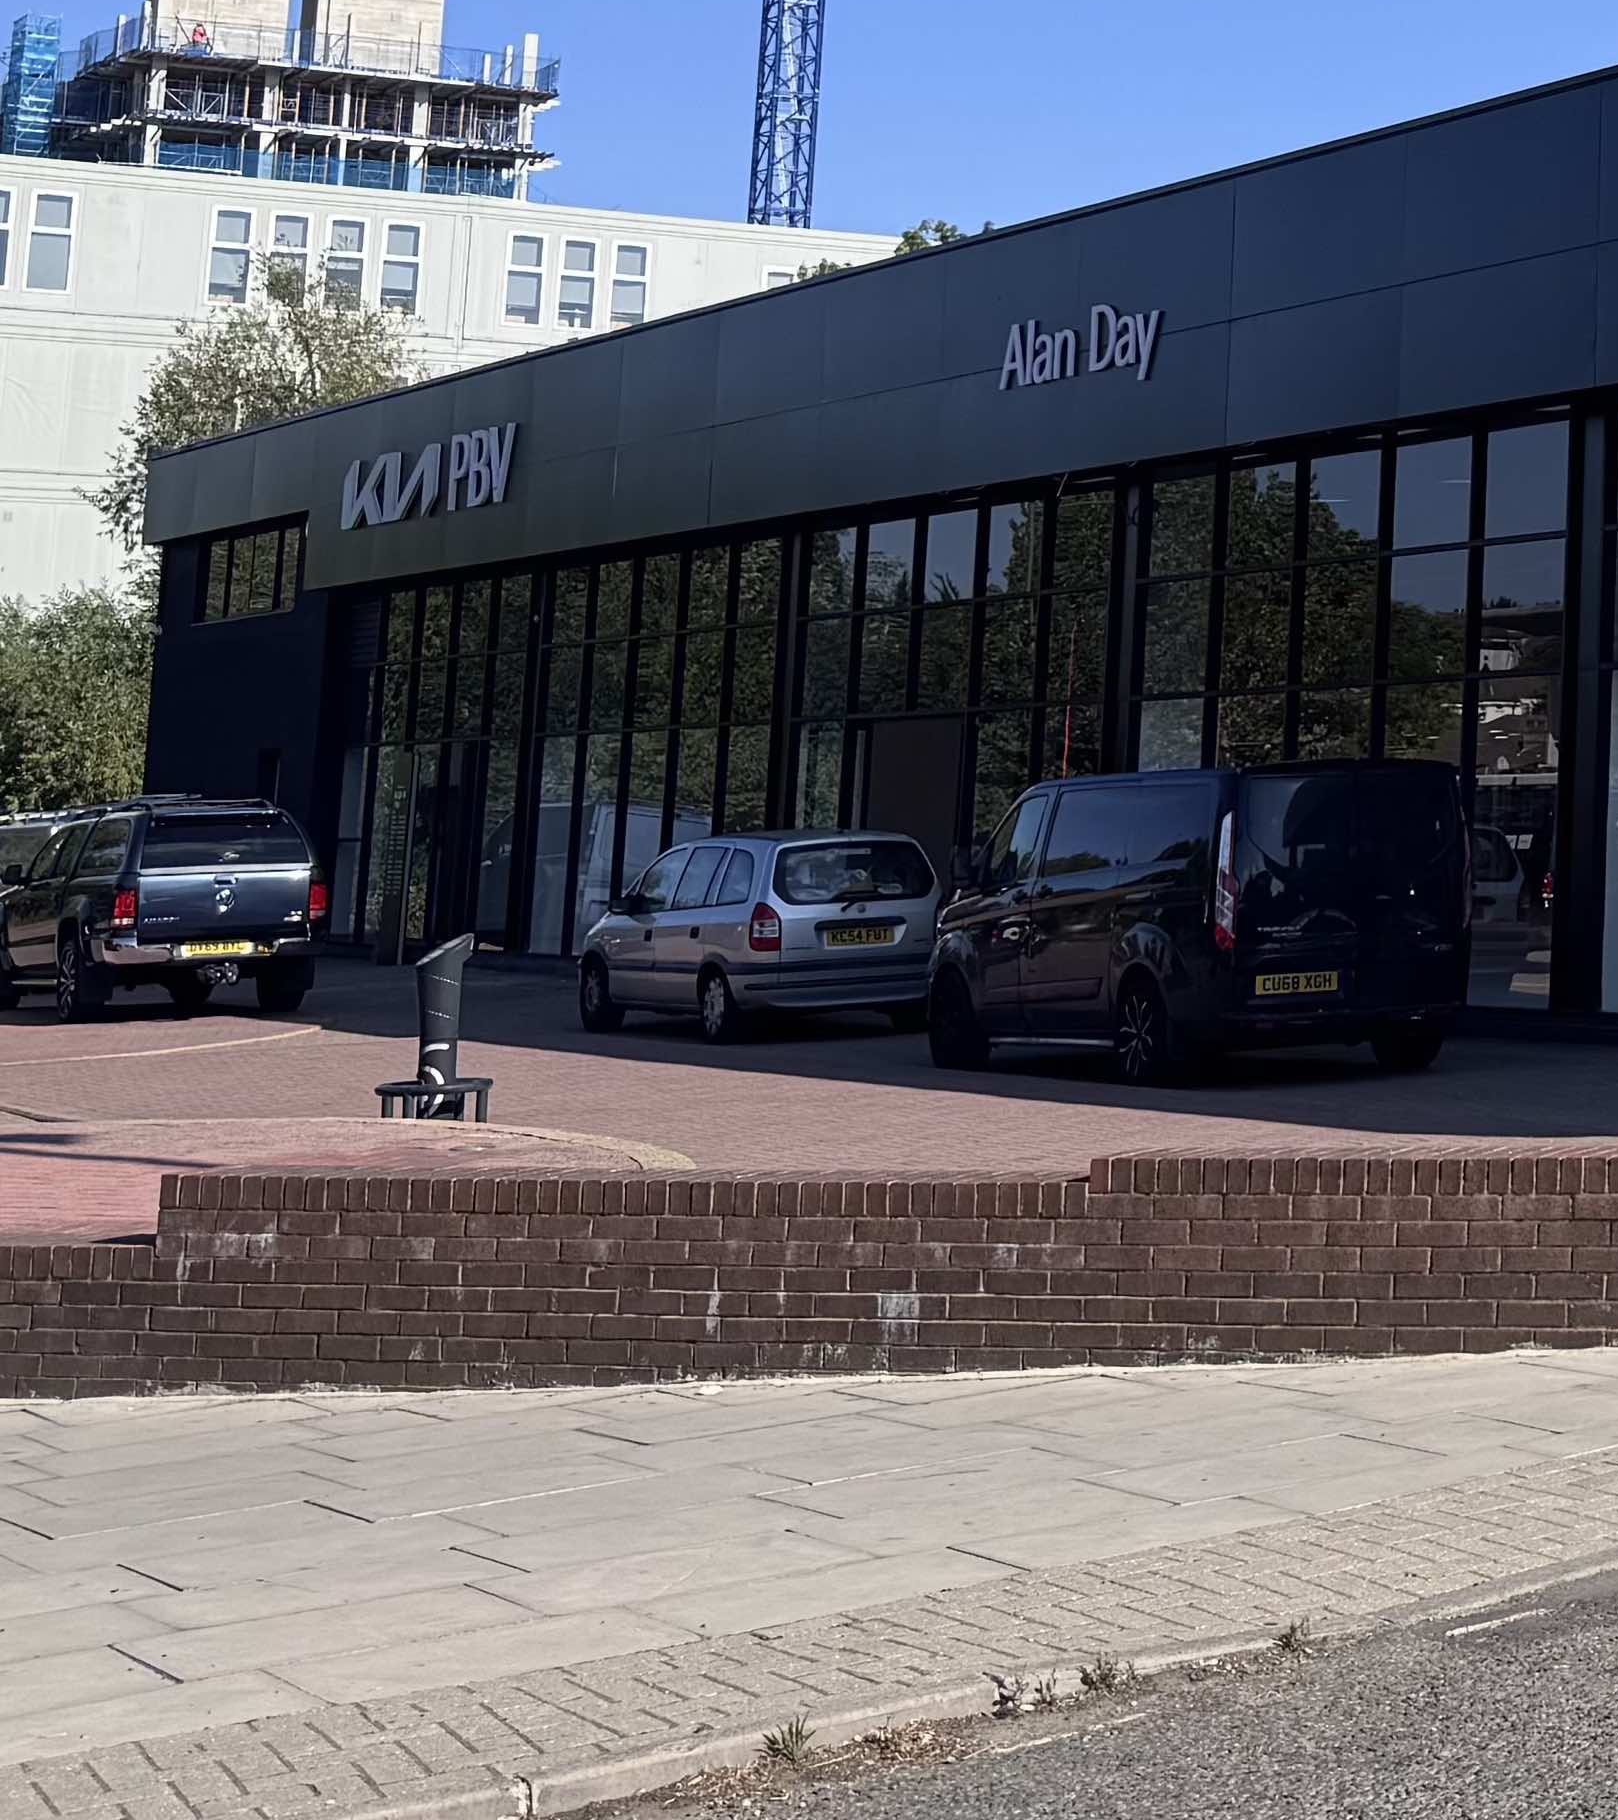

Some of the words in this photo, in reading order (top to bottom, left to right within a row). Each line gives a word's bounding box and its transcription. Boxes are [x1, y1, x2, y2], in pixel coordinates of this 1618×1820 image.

[998, 318, 1077, 390] Alan
[1087, 303, 1160, 381] Day
[340, 443, 442, 530] KIA
[446, 422, 517, 512] PBV
[1262, 975, 1300, 992] CU68
[1303, 973, 1333, 989] XGH
